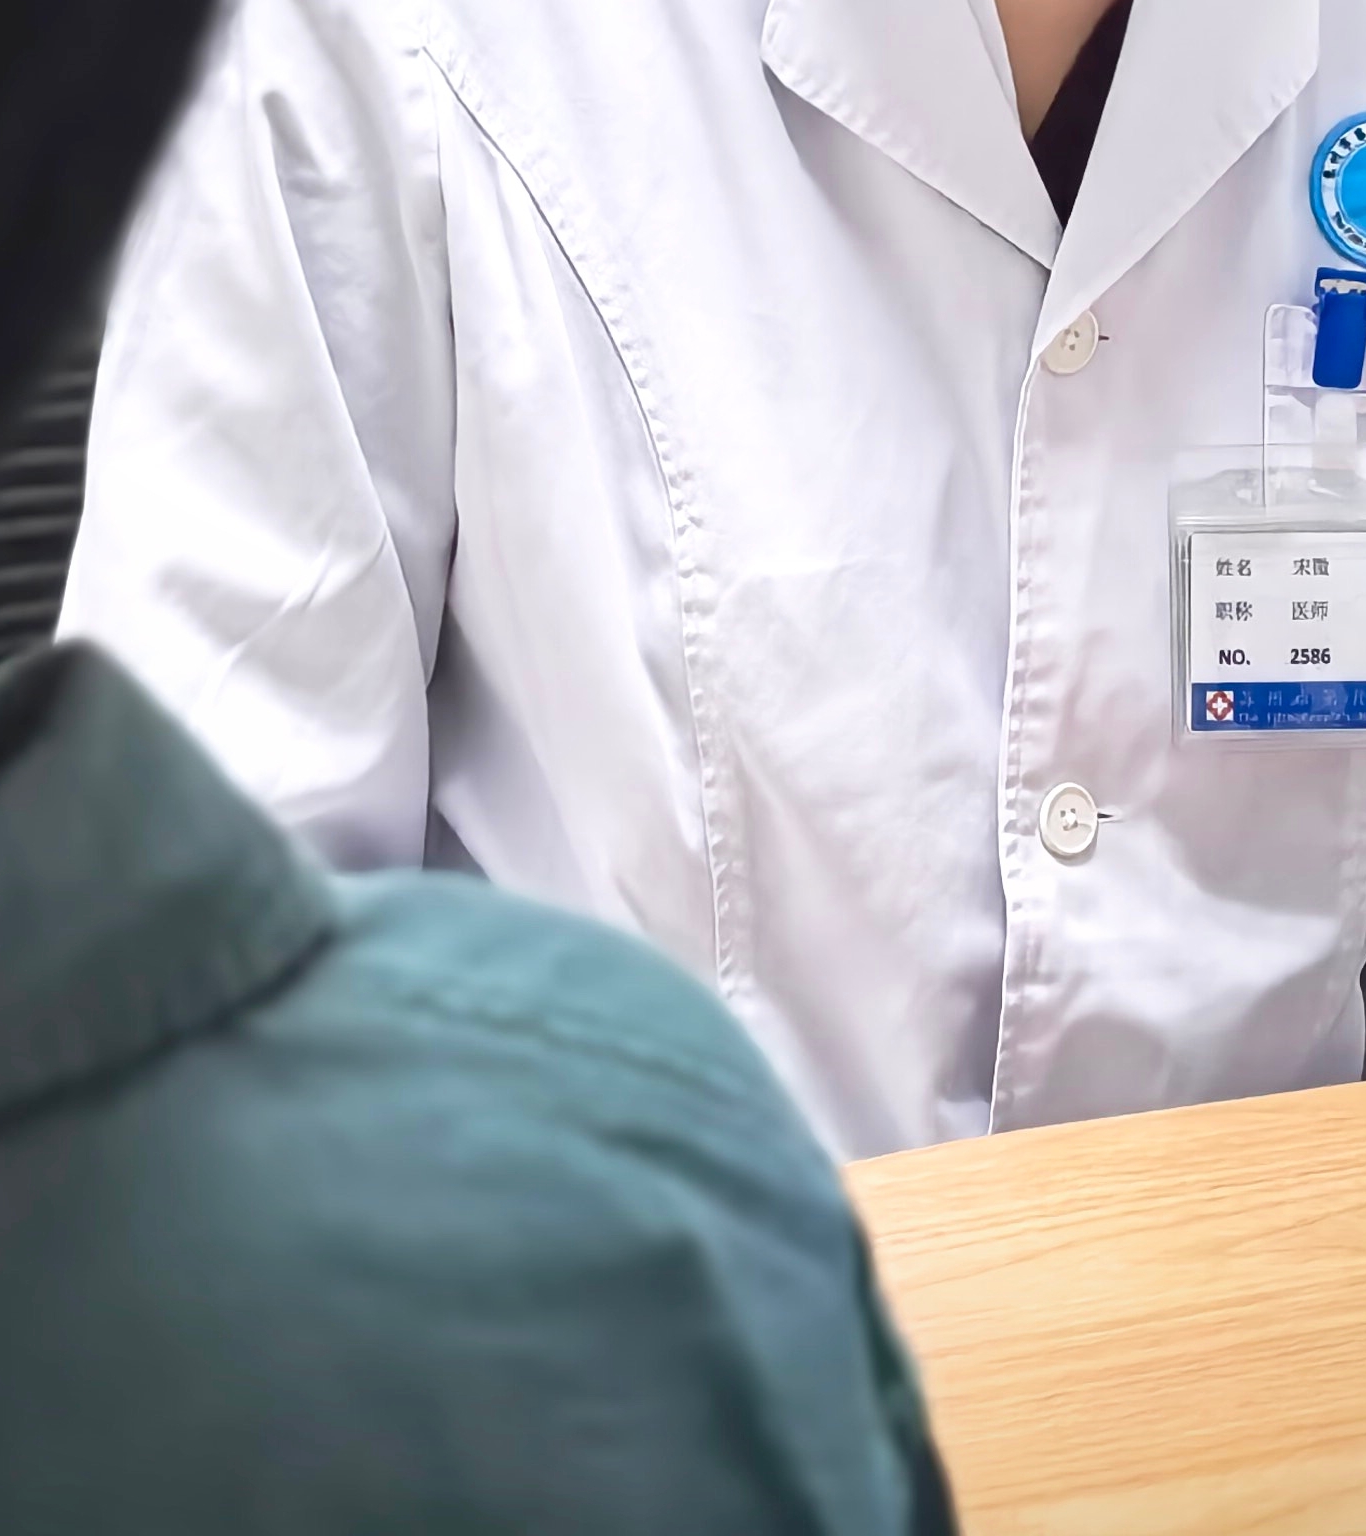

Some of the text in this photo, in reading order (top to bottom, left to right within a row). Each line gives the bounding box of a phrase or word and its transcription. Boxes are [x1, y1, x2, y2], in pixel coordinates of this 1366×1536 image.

[1215, 557, 1252, 576] 姓名
[1215, 600, 1329, 621] 职称 医师
[1219, 647, 1331, 665] NO. 2586
